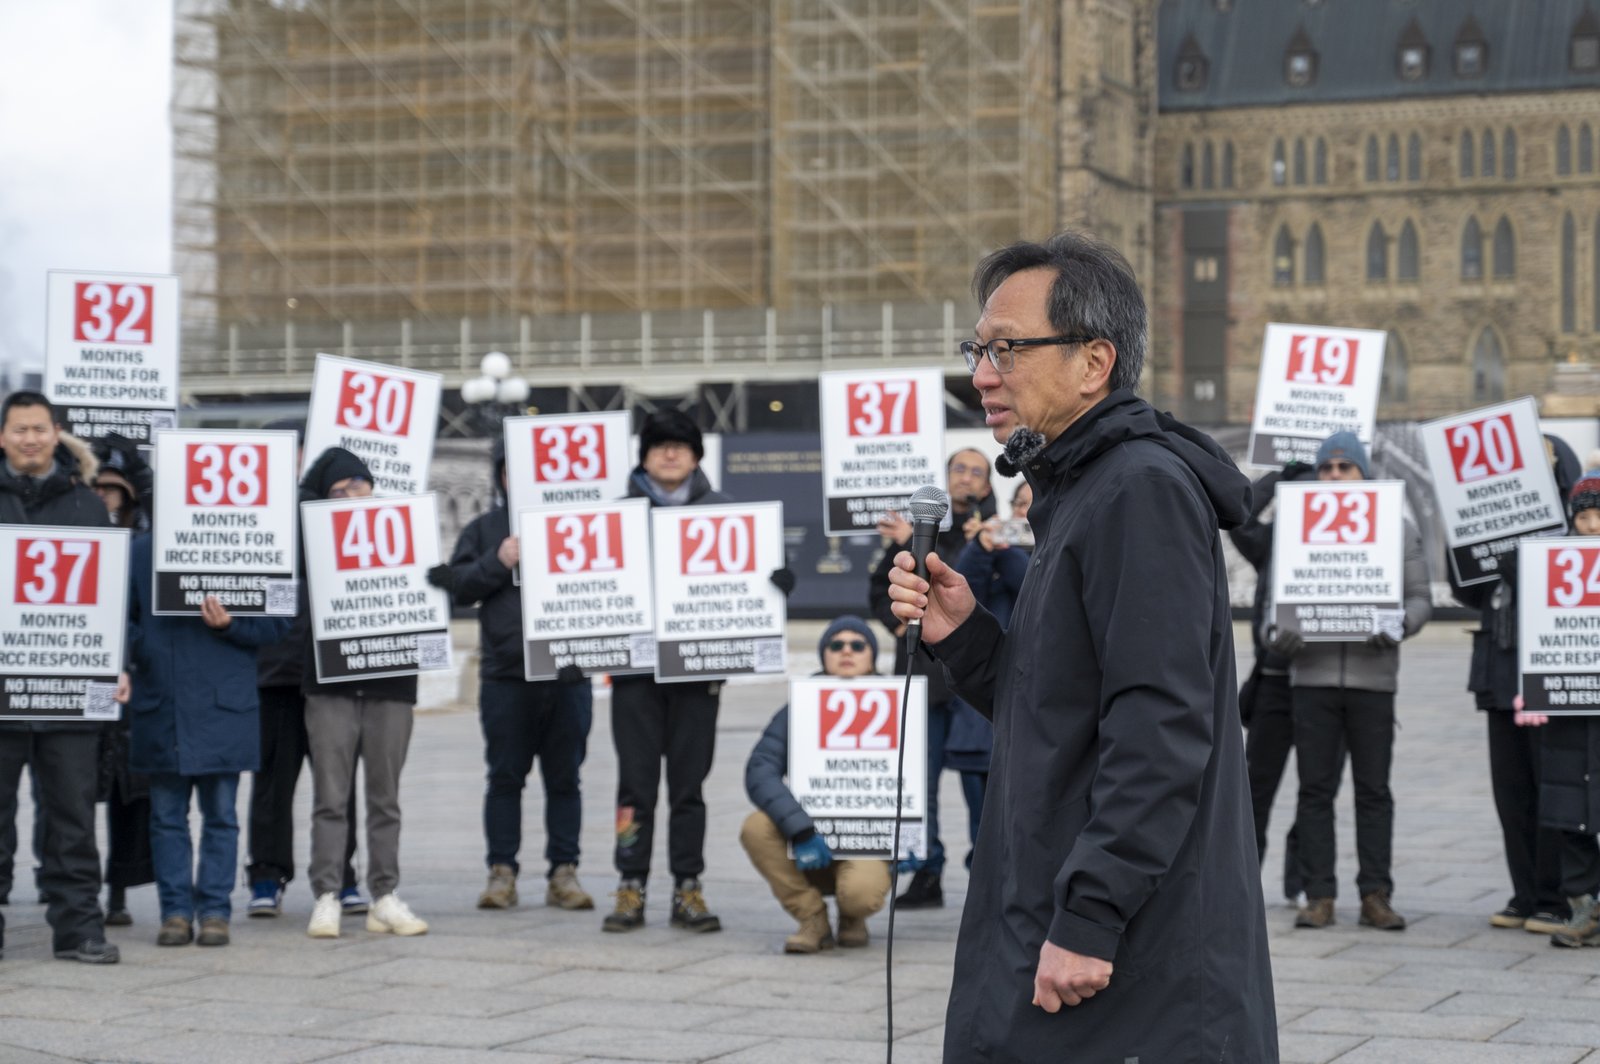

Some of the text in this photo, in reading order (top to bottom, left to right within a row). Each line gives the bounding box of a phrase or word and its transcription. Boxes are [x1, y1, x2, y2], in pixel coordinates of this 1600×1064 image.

[80, 283, 147, 342] 32
[81, 349, 143, 364] MONTHS
[1294, 337, 1349, 384] 19
[64, 367, 159, 383] WAITING FOR
[54, 384, 167, 401] IRCC RESPONSE
[1290, 389, 1345, 402] MONTHS
[343, 372, 407, 435] 30
[854, 382, 911, 435] 37
[1275, 403, 1357, 418] WAITING FOR
[67, 408, 87, 422] NO
[1264, 417, 1291, 428] IRCC
[72, 423, 92, 437] NO
[340, 436, 398, 456] MONTHS
[856, 443, 912, 455] MONTHS
[1272, 437, 1290, 450] NO
[1453, 417, 1514, 481] 20
[541, 426, 600, 481] 33
[384, 461, 411, 475] FOR
[843, 457, 928, 472] WAITING FOR
[192, 445, 261, 505] 38
[834, 474, 935, 489] IRCC RESPONSE
[542, 489, 601, 503] MONTHS
[1467, 479, 1522, 500] MONTHS
[847, 499, 865, 512] NO
[1458, 491, 1540, 519] WAITING FOR
[192, 513, 257, 526] MONTHS
[852, 512, 870, 526] NO
[1309, 493, 1370, 543] 23
[1455, 506, 1551, 538] IRCC RESPONSE
[175, 532, 274, 546] WAITING FOR
[342, 506, 407, 567] 40
[555, 515, 616, 572] 31
[686, 517, 749, 573] 20
[1471, 544, 1489, 559] NO
[165, 550, 283, 565] IRCC RESPONSE
[1309, 552, 1368, 563] MONTHS
[1480, 556, 1498, 572] NO
[23, 540, 91, 605] 37
[1294, 568, 1383, 579] WAITING FOR
[179, 575, 200, 590] NO
[345, 576, 408, 591] MONTHS
[557, 580, 618, 595] MONTHS
[688, 583, 748, 597] MONTHS
[1285, 583, 1391, 596] IRCC RESPONSE
[185, 590, 204, 605] NO
[331, 592, 426, 611] WAITING FOR
[542, 596, 634, 613] WAITING FOR
[673, 598, 765, 614] WAITING FOR
[1296, 605, 1314, 619] NO
[20, 613, 87, 628] MONTHS
[324, 609, 437, 631] IRCC RESPONSE
[534, 613, 643, 632] IRCC RESPONSE
[665, 614, 774, 633] IRCC RESPONSE
[1301, 619, 1371, 632] NO RESULTS
[2, 632, 103, 647] WAITING FOR
[340, 635, 418, 655] NO TIMELINE
[1539, 634, 1599, 646] WAITING
[549, 641, 568, 656] NO
[679, 639, 754, 657] NO TIMELINE
[29, 652, 111, 667] RESPONSE
[347, 655, 366, 669] NO
[575, 651, 628, 668] RESULTS
[685, 656, 703, 671] NO
[1530, 652, 1561, 665] IRCC
[5, 678, 24, 693] NO
[1544, 676, 1562, 690] NO
[9, 694, 29, 709] NO
[1549, 691, 1567, 704] NO
[826, 690, 890, 749] 22
[825, 759, 889, 772] MONTHS
[809, 777, 871, 790] WAITING
[801, 795, 832, 809] IRCC
[814, 820, 892, 834] NO TIMELINE
